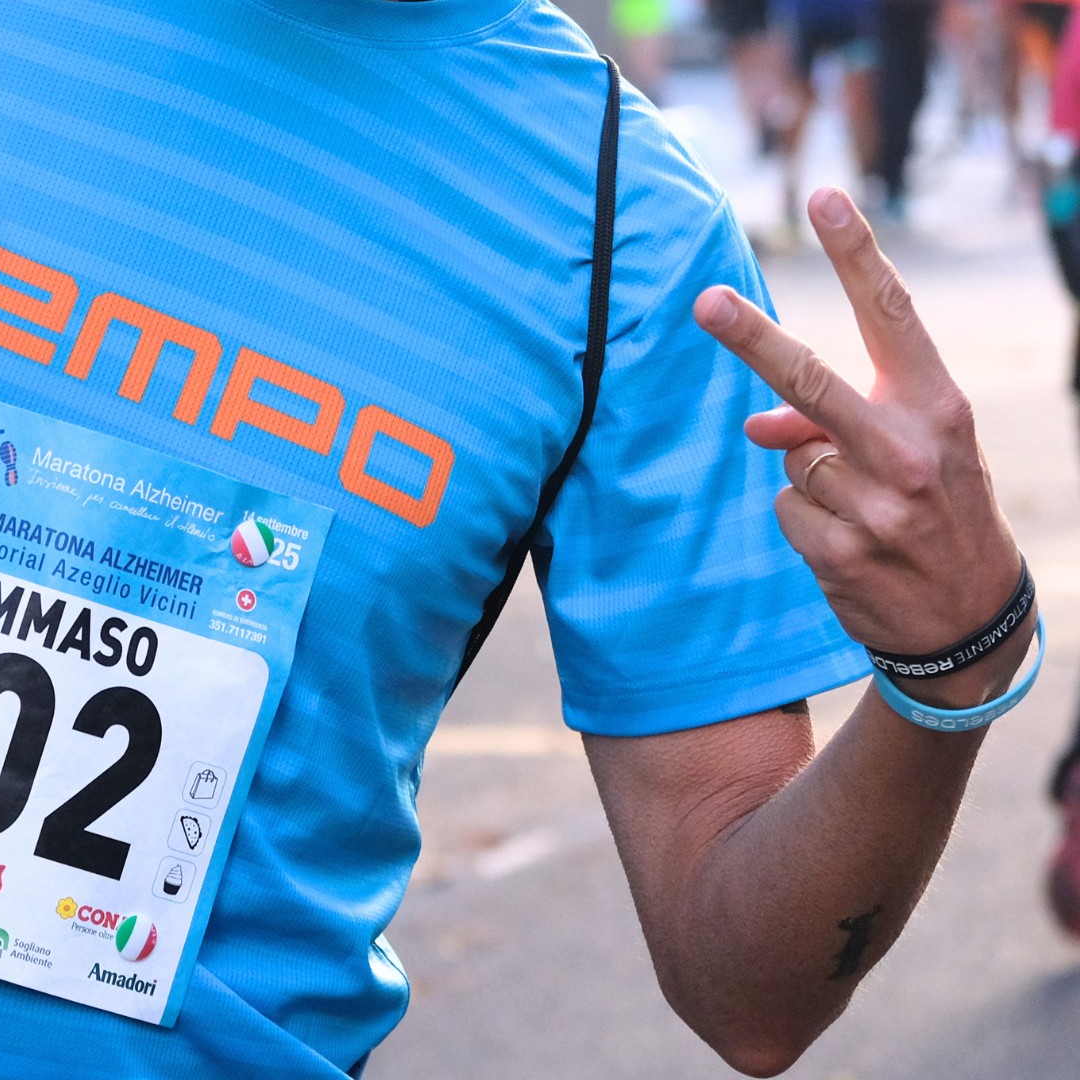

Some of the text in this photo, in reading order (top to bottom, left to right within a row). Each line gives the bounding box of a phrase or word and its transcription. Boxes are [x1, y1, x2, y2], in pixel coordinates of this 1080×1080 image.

[32, 447, 224, 524] Maratona Alzheimer
[243, 510, 309, 540] 14 settembre
[266, 537, 302, 571] 25
[99, 546, 204, 596] ALZHEIMER
[52, 558, 131, 599] Azeglio
[139, 587, 198, 621] Vicini
[208, 620, 267, 645] 351.7117391
[71, 922, 113, 940] Persone oltre
[78, 905, 126, 931] CON
[10, 949, 53, 969] Ambiente
[13, 938, 51, 957] Sogliano
[87, 962, 158, 996] Amadori
